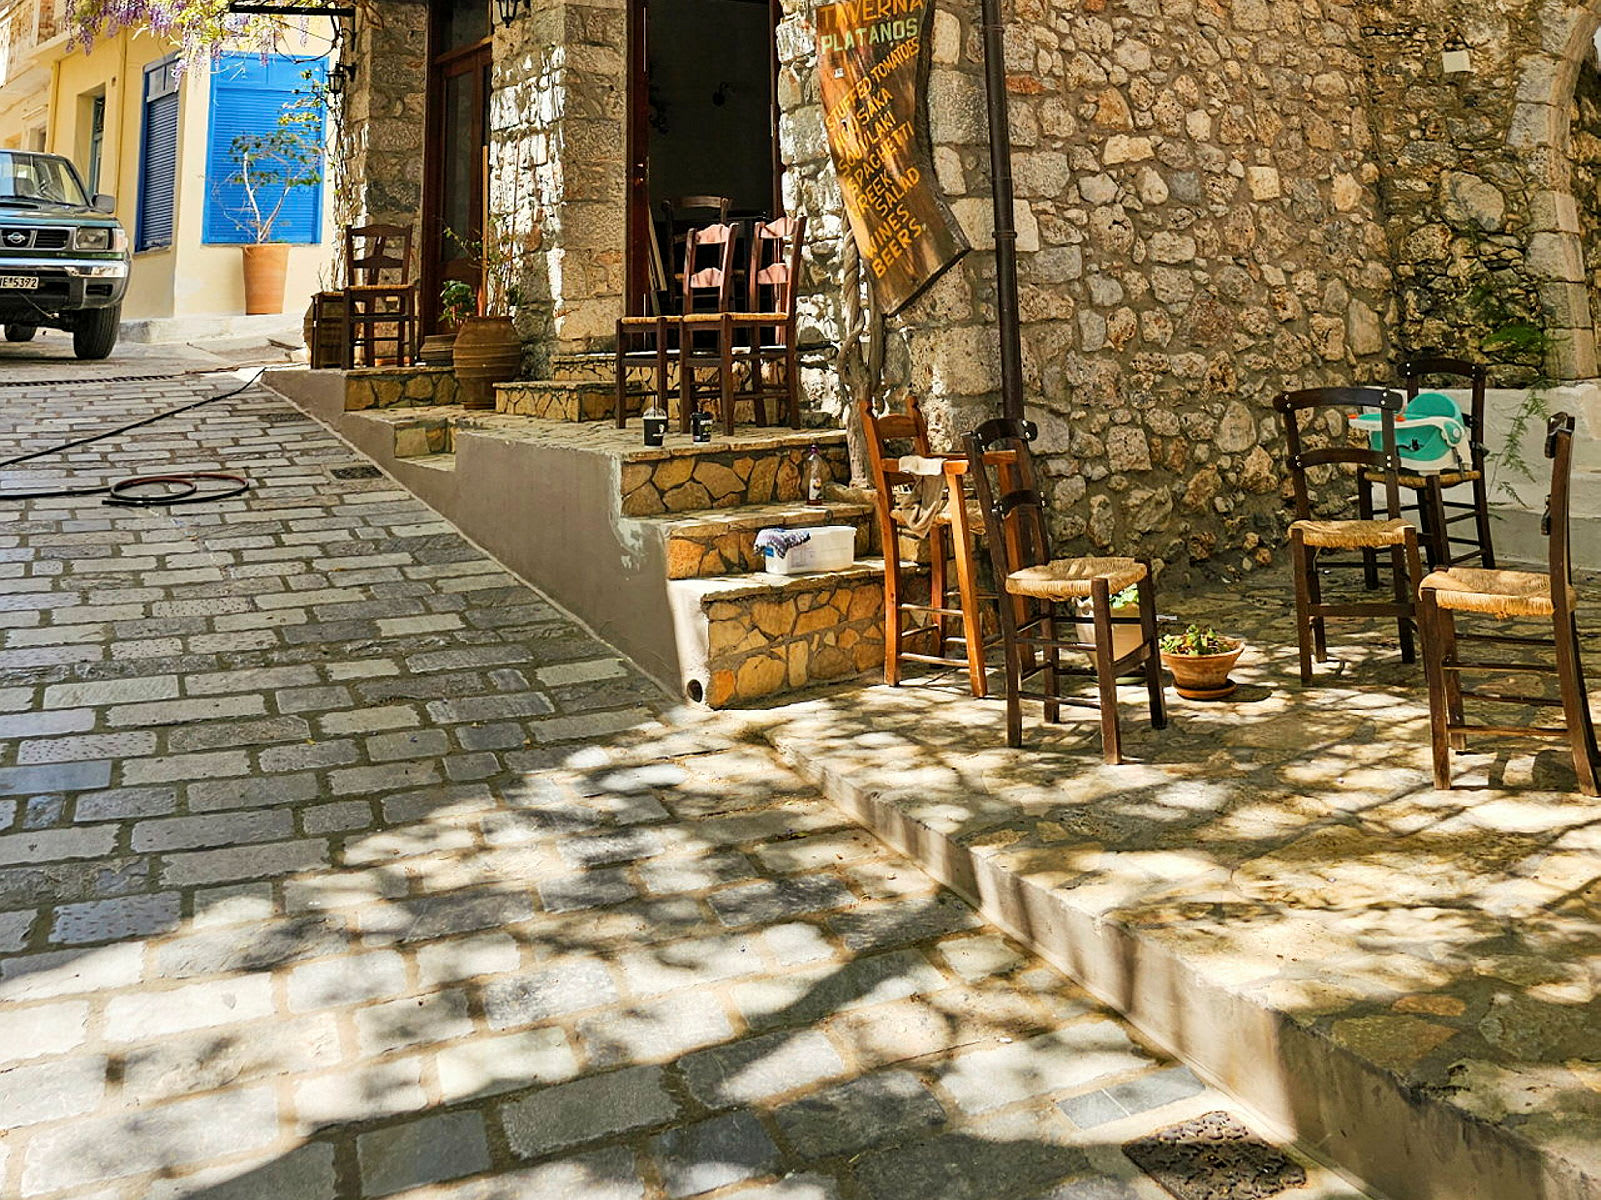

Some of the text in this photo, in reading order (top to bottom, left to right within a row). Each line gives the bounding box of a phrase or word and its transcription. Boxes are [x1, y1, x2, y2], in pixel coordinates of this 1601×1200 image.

[819, 18, 919, 55] PLATANOS
[825, 36, 921, 132] STUFFED TOMATOES
[838, 110, 896, 178] SOUVLAKI
[846, 121, 915, 193] SPAGHETTI
[876, 168, 920, 216] SALAD
[867, 203, 910, 259] WINES
